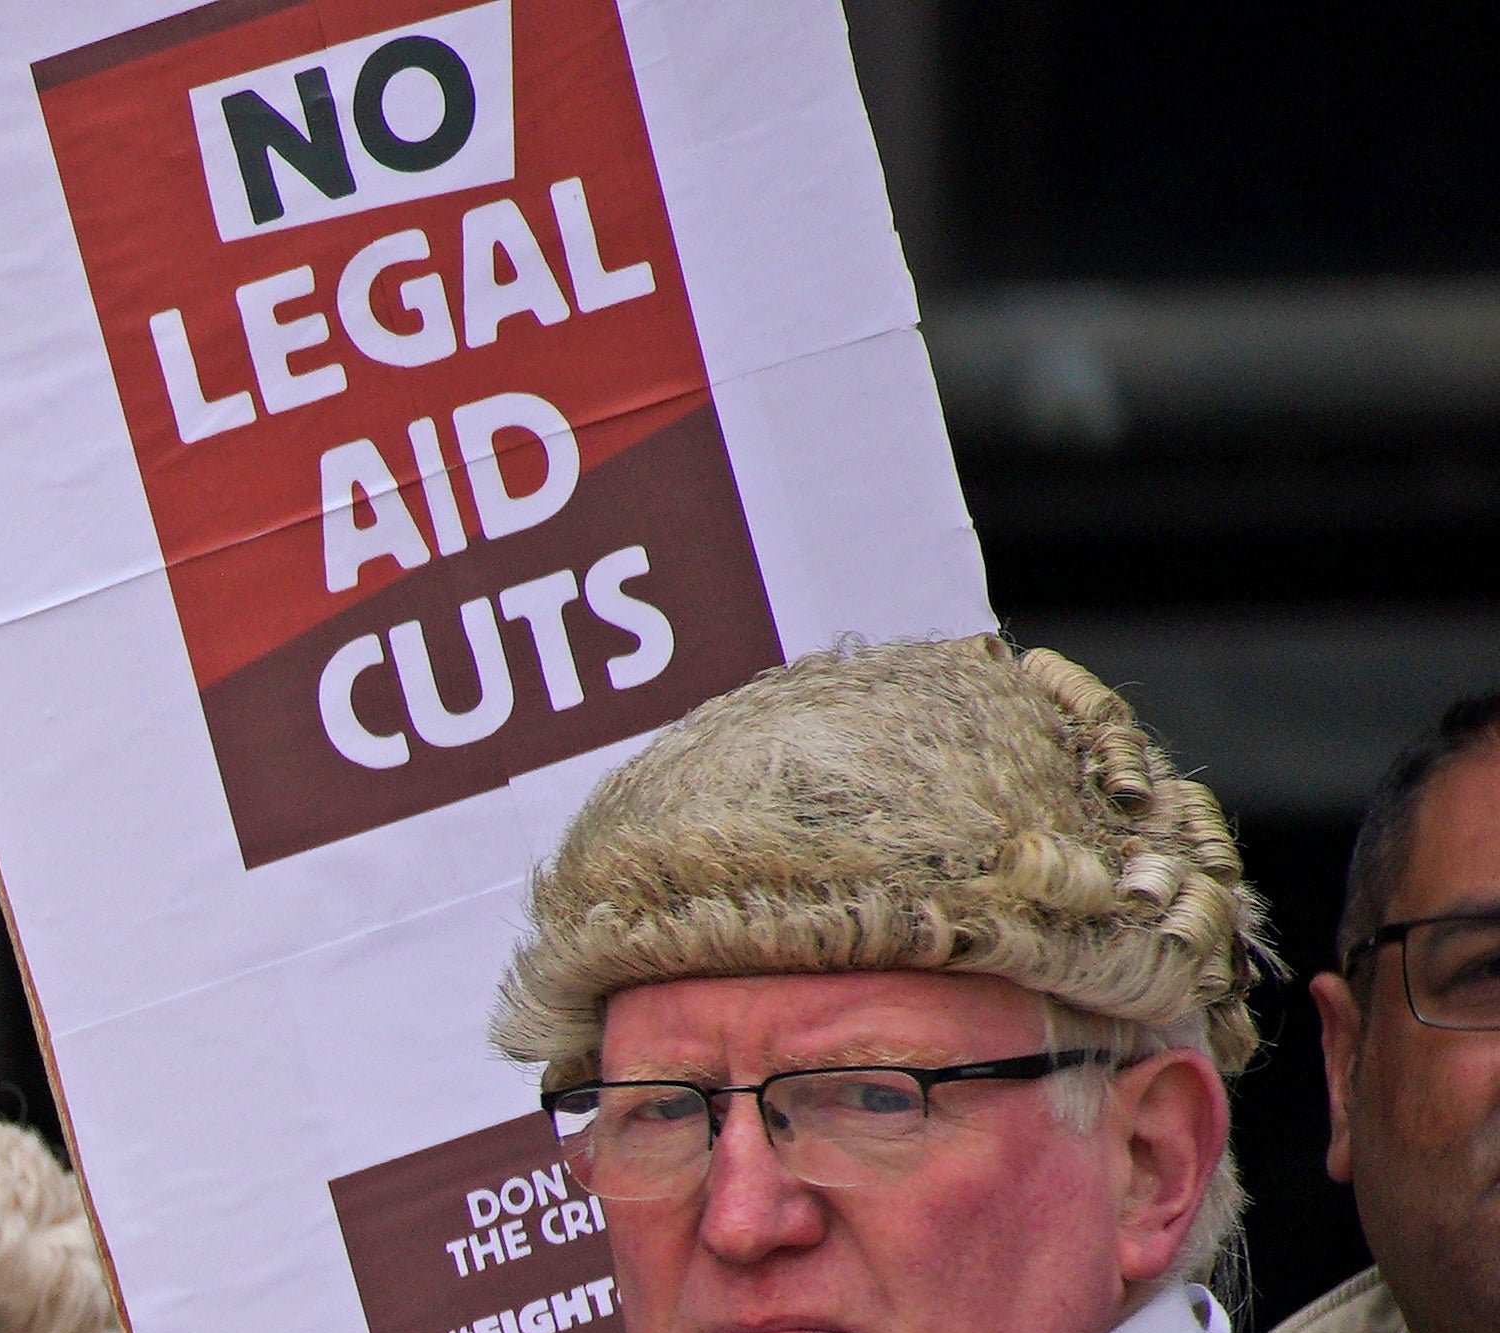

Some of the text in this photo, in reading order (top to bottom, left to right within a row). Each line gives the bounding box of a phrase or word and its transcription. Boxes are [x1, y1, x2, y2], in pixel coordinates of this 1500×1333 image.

[221, 35, 477, 227] NO
[148, 176, 657, 445] LEGAL
[318, 391, 580, 595] AID
[317, 545, 676, 770] CUTS
[445, 1195, 607, 1278] THE CRI
[466, 1160, 571, 1229] DON'
